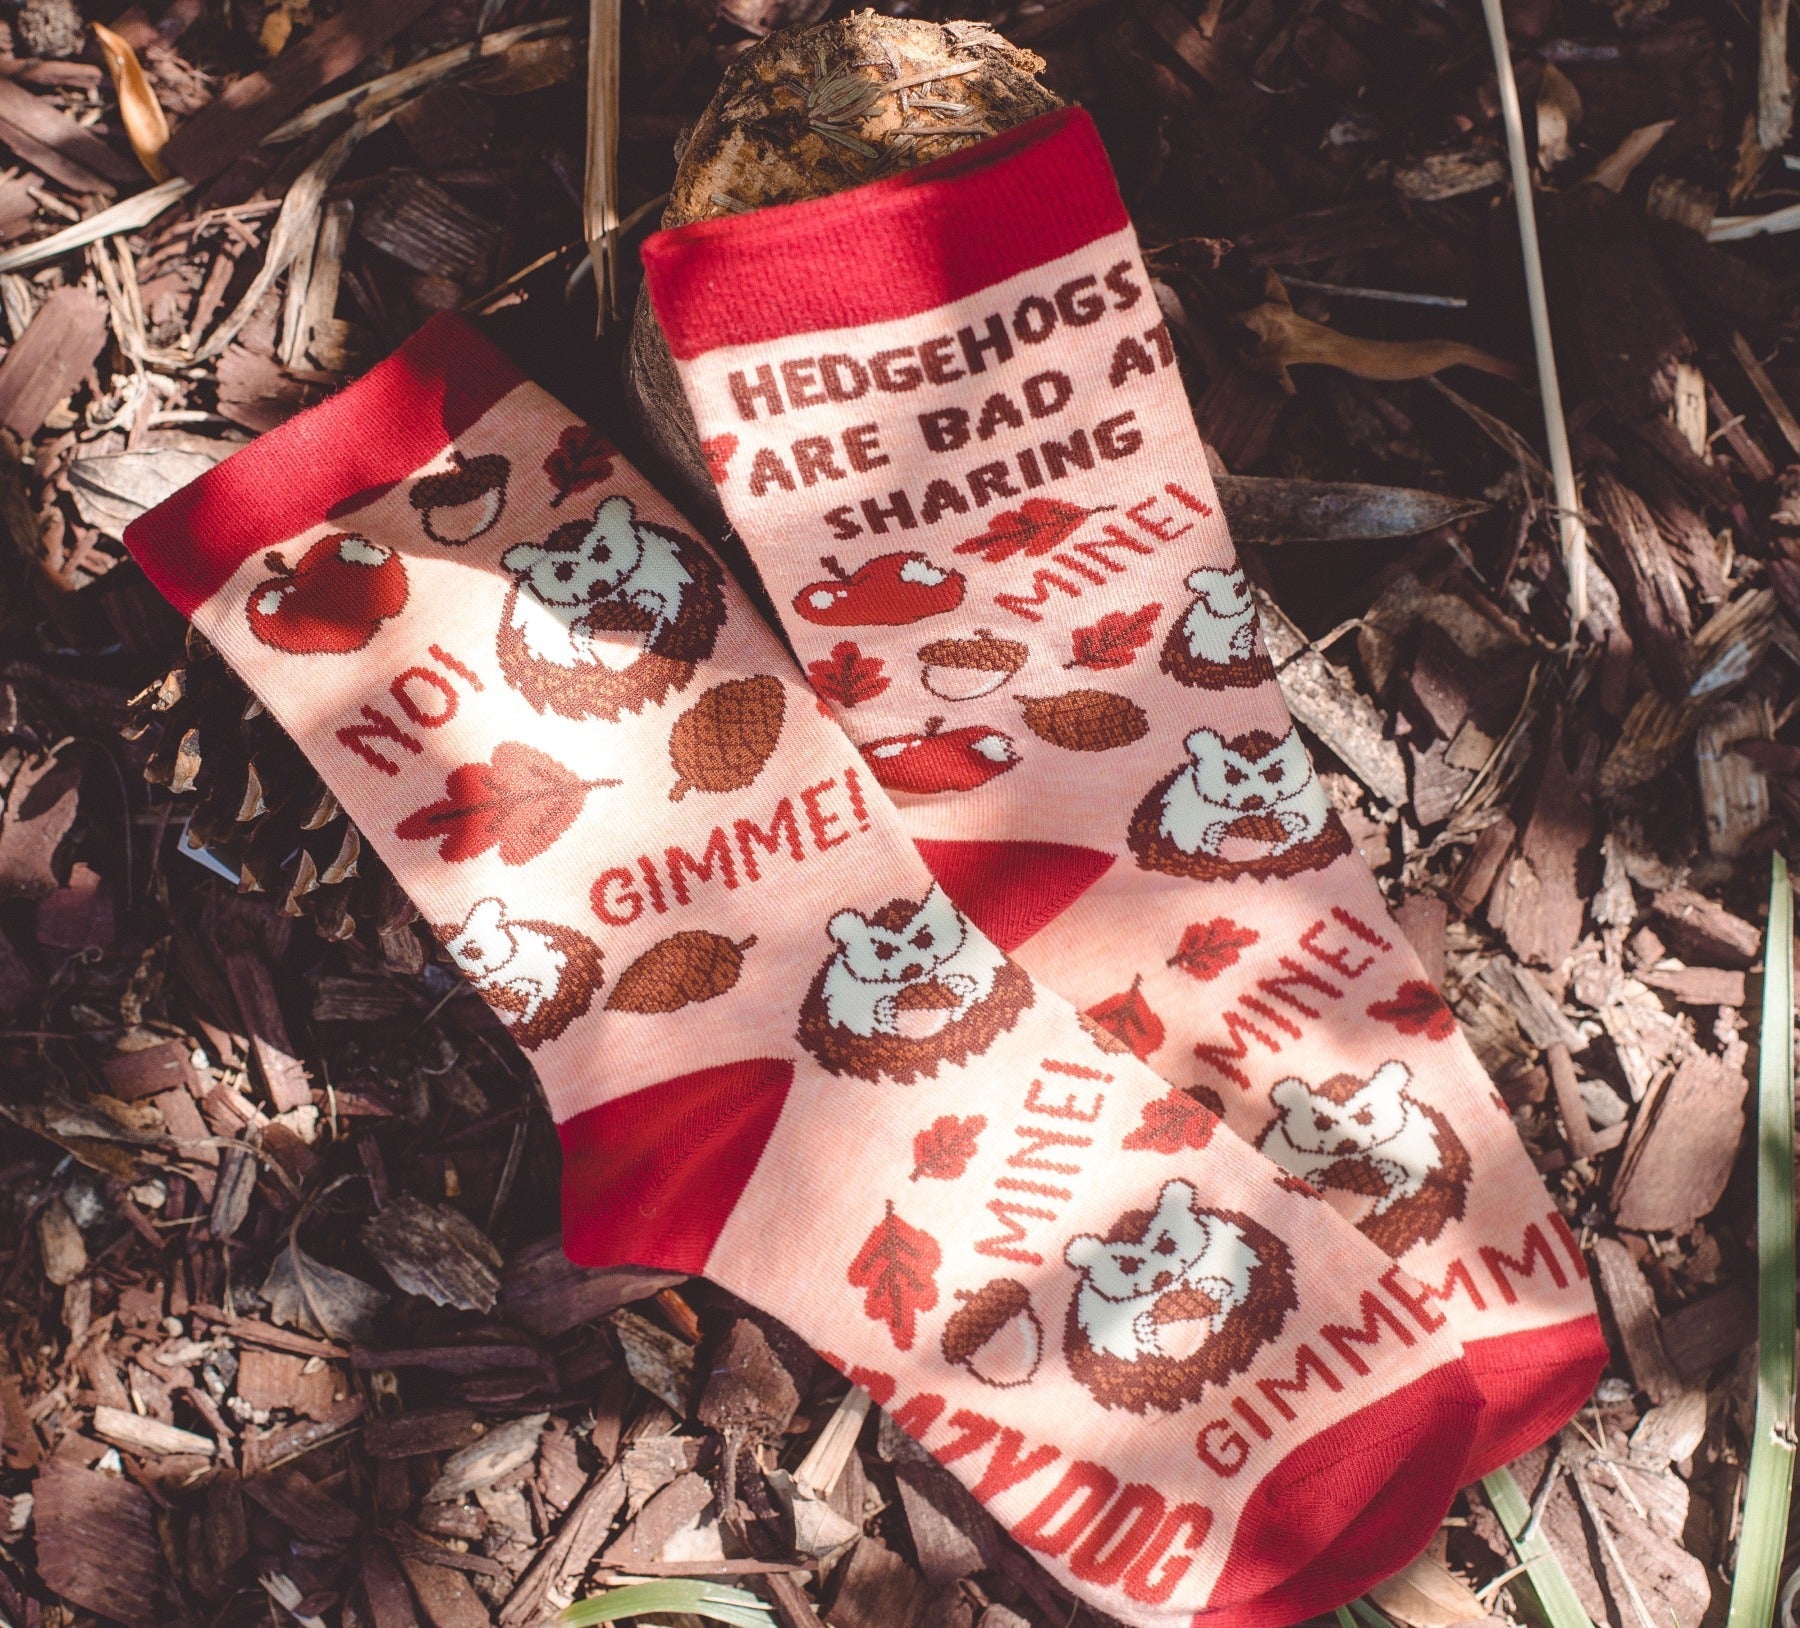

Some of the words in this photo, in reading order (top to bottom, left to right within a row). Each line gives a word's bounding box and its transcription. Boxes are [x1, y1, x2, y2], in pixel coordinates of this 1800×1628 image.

[727, 259, 1143, 421] HEDGEHOGS
[748, 422, 890, 497] ARE
[917, 370, 1074, 454] BAD
[1108, 319, 1175, 390] AT
[823, 410, 1143, 541] SHARING
[993, 483, 1213, 623] MINE!
[336, 644, 485, 776] NO!
[589, 767, 871, 926] GIMME!
[1194, 906, 1393, 1090] MINE!
[974, 1057, 1114, 1266] MINE!
[1008, 1460, 1214, 1605] DOG
